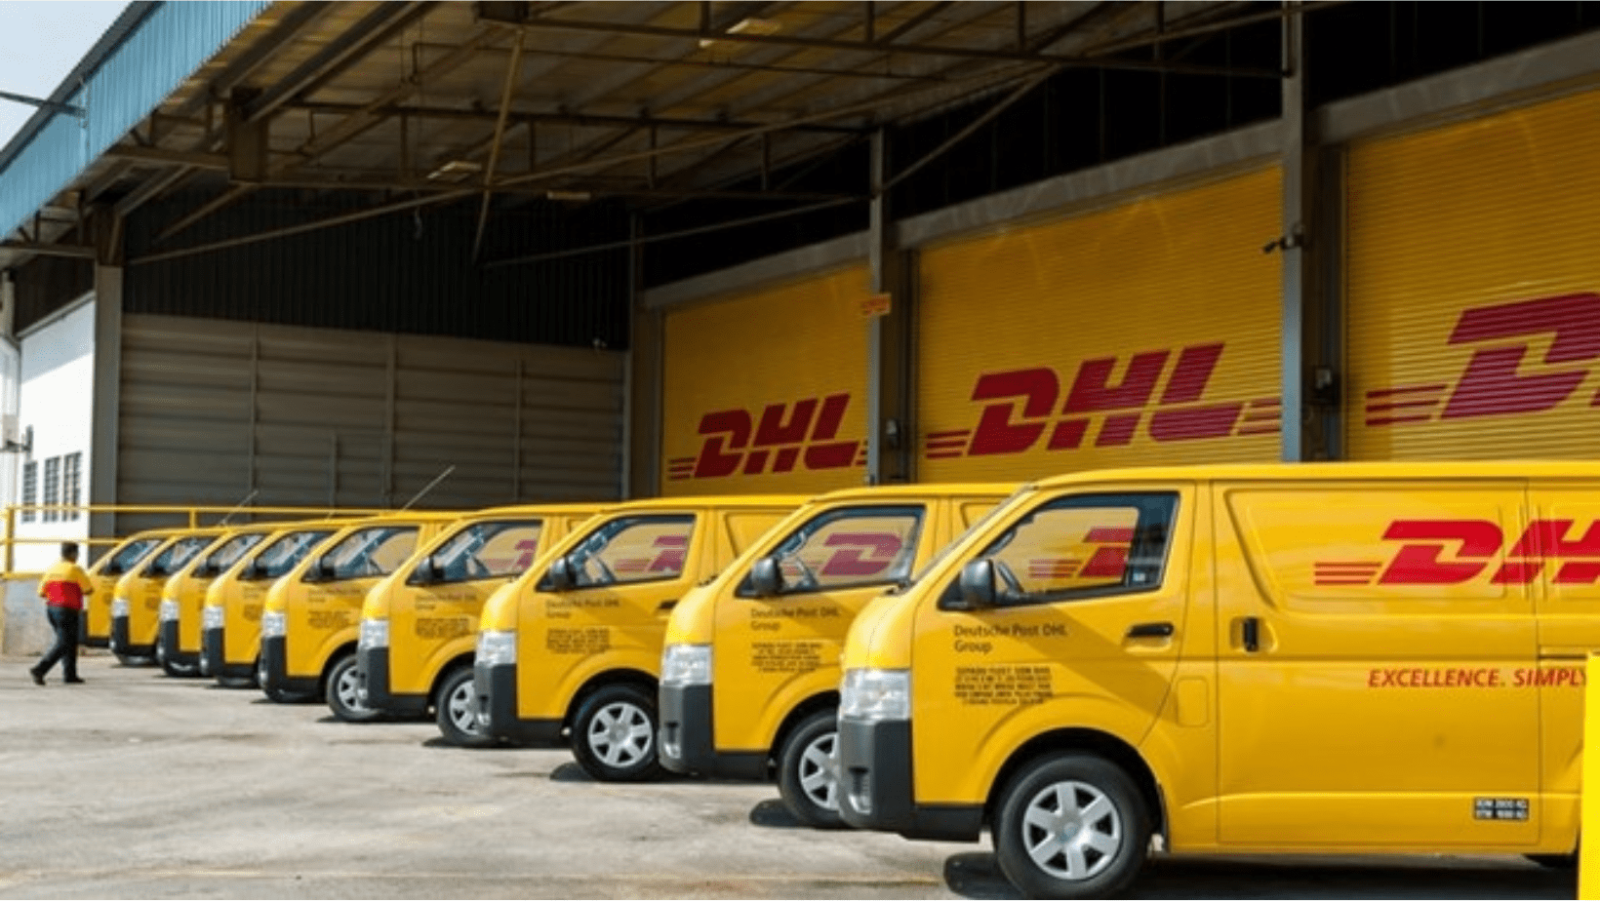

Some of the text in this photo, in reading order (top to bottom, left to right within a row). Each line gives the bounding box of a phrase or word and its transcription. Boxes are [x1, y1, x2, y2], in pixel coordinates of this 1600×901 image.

[967, 342, 1243, 456] DHL
[694, 393, 859, 478] DHL
[954, 623, 1068, 636] Deutsche Post DHL
[954, 640, 993, 655] Group
[1368, 668, 1506, 687] EXCELLENCE.
